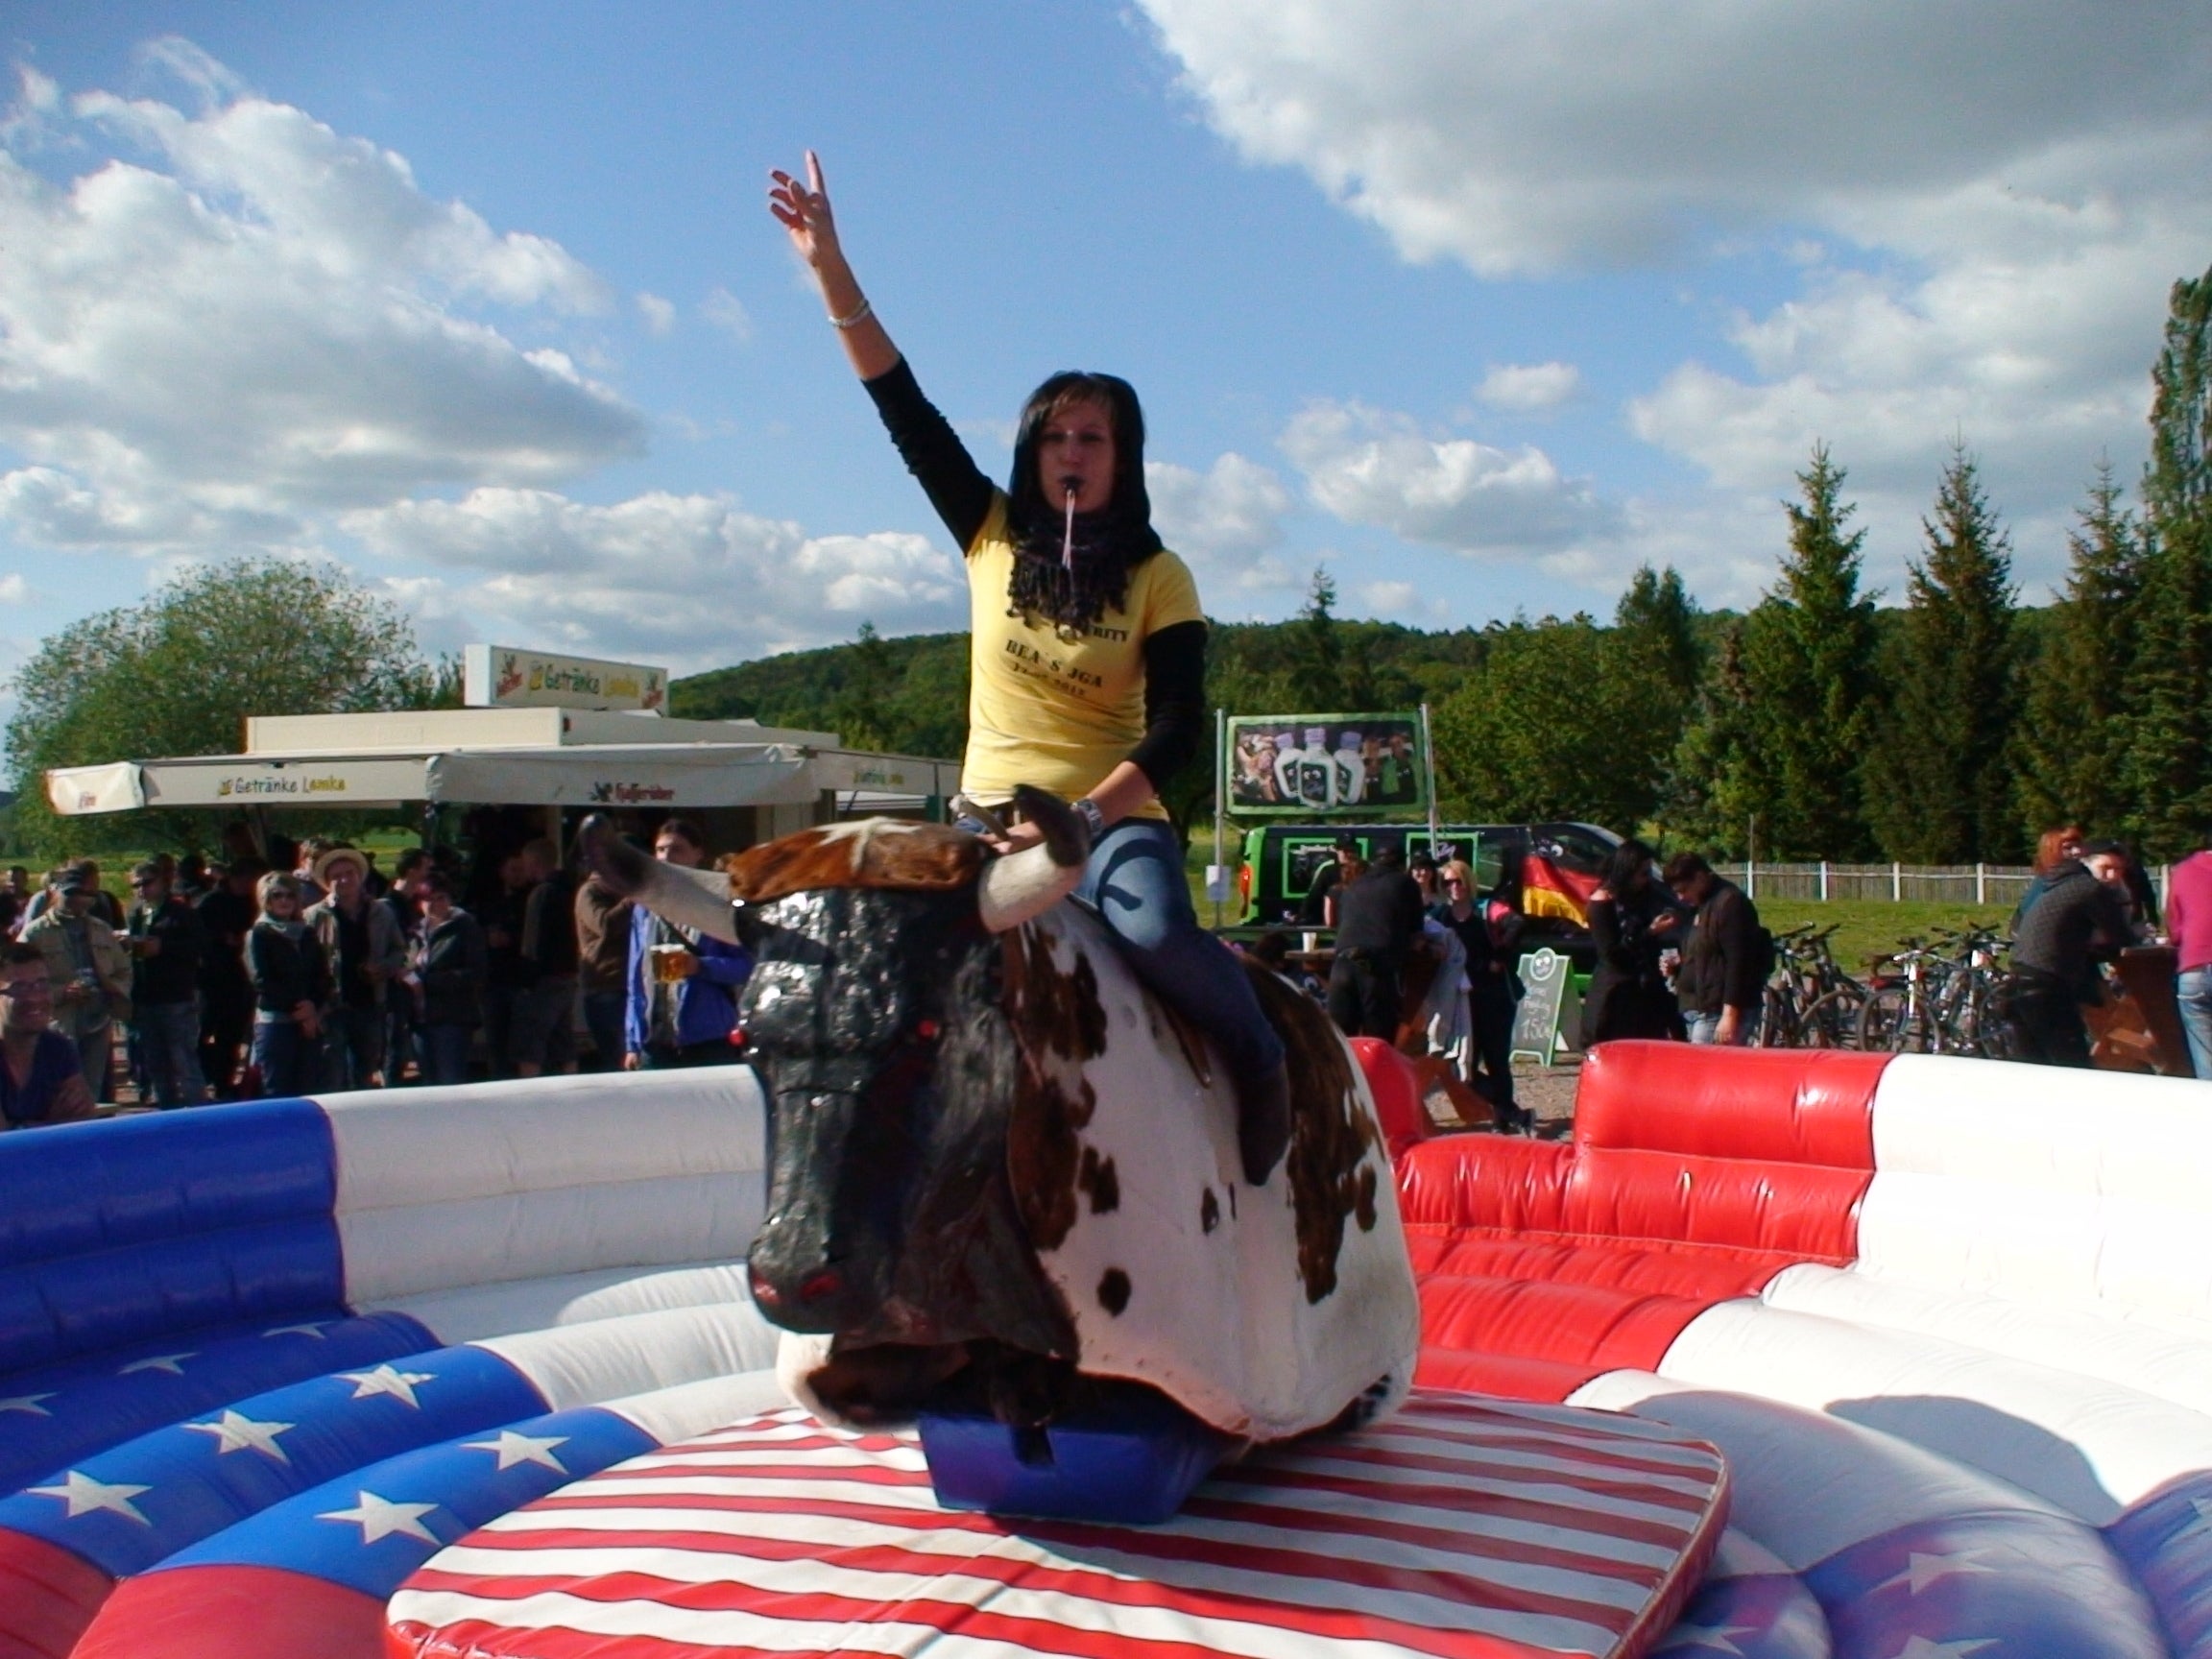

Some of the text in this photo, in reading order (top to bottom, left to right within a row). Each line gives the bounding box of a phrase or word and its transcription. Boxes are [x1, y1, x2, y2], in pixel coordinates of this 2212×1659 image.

[1092, 626, 1130, 641] RITY
[1068, 667, 1101, 687] JGA
[235, 776, 298, 794] Getränke
